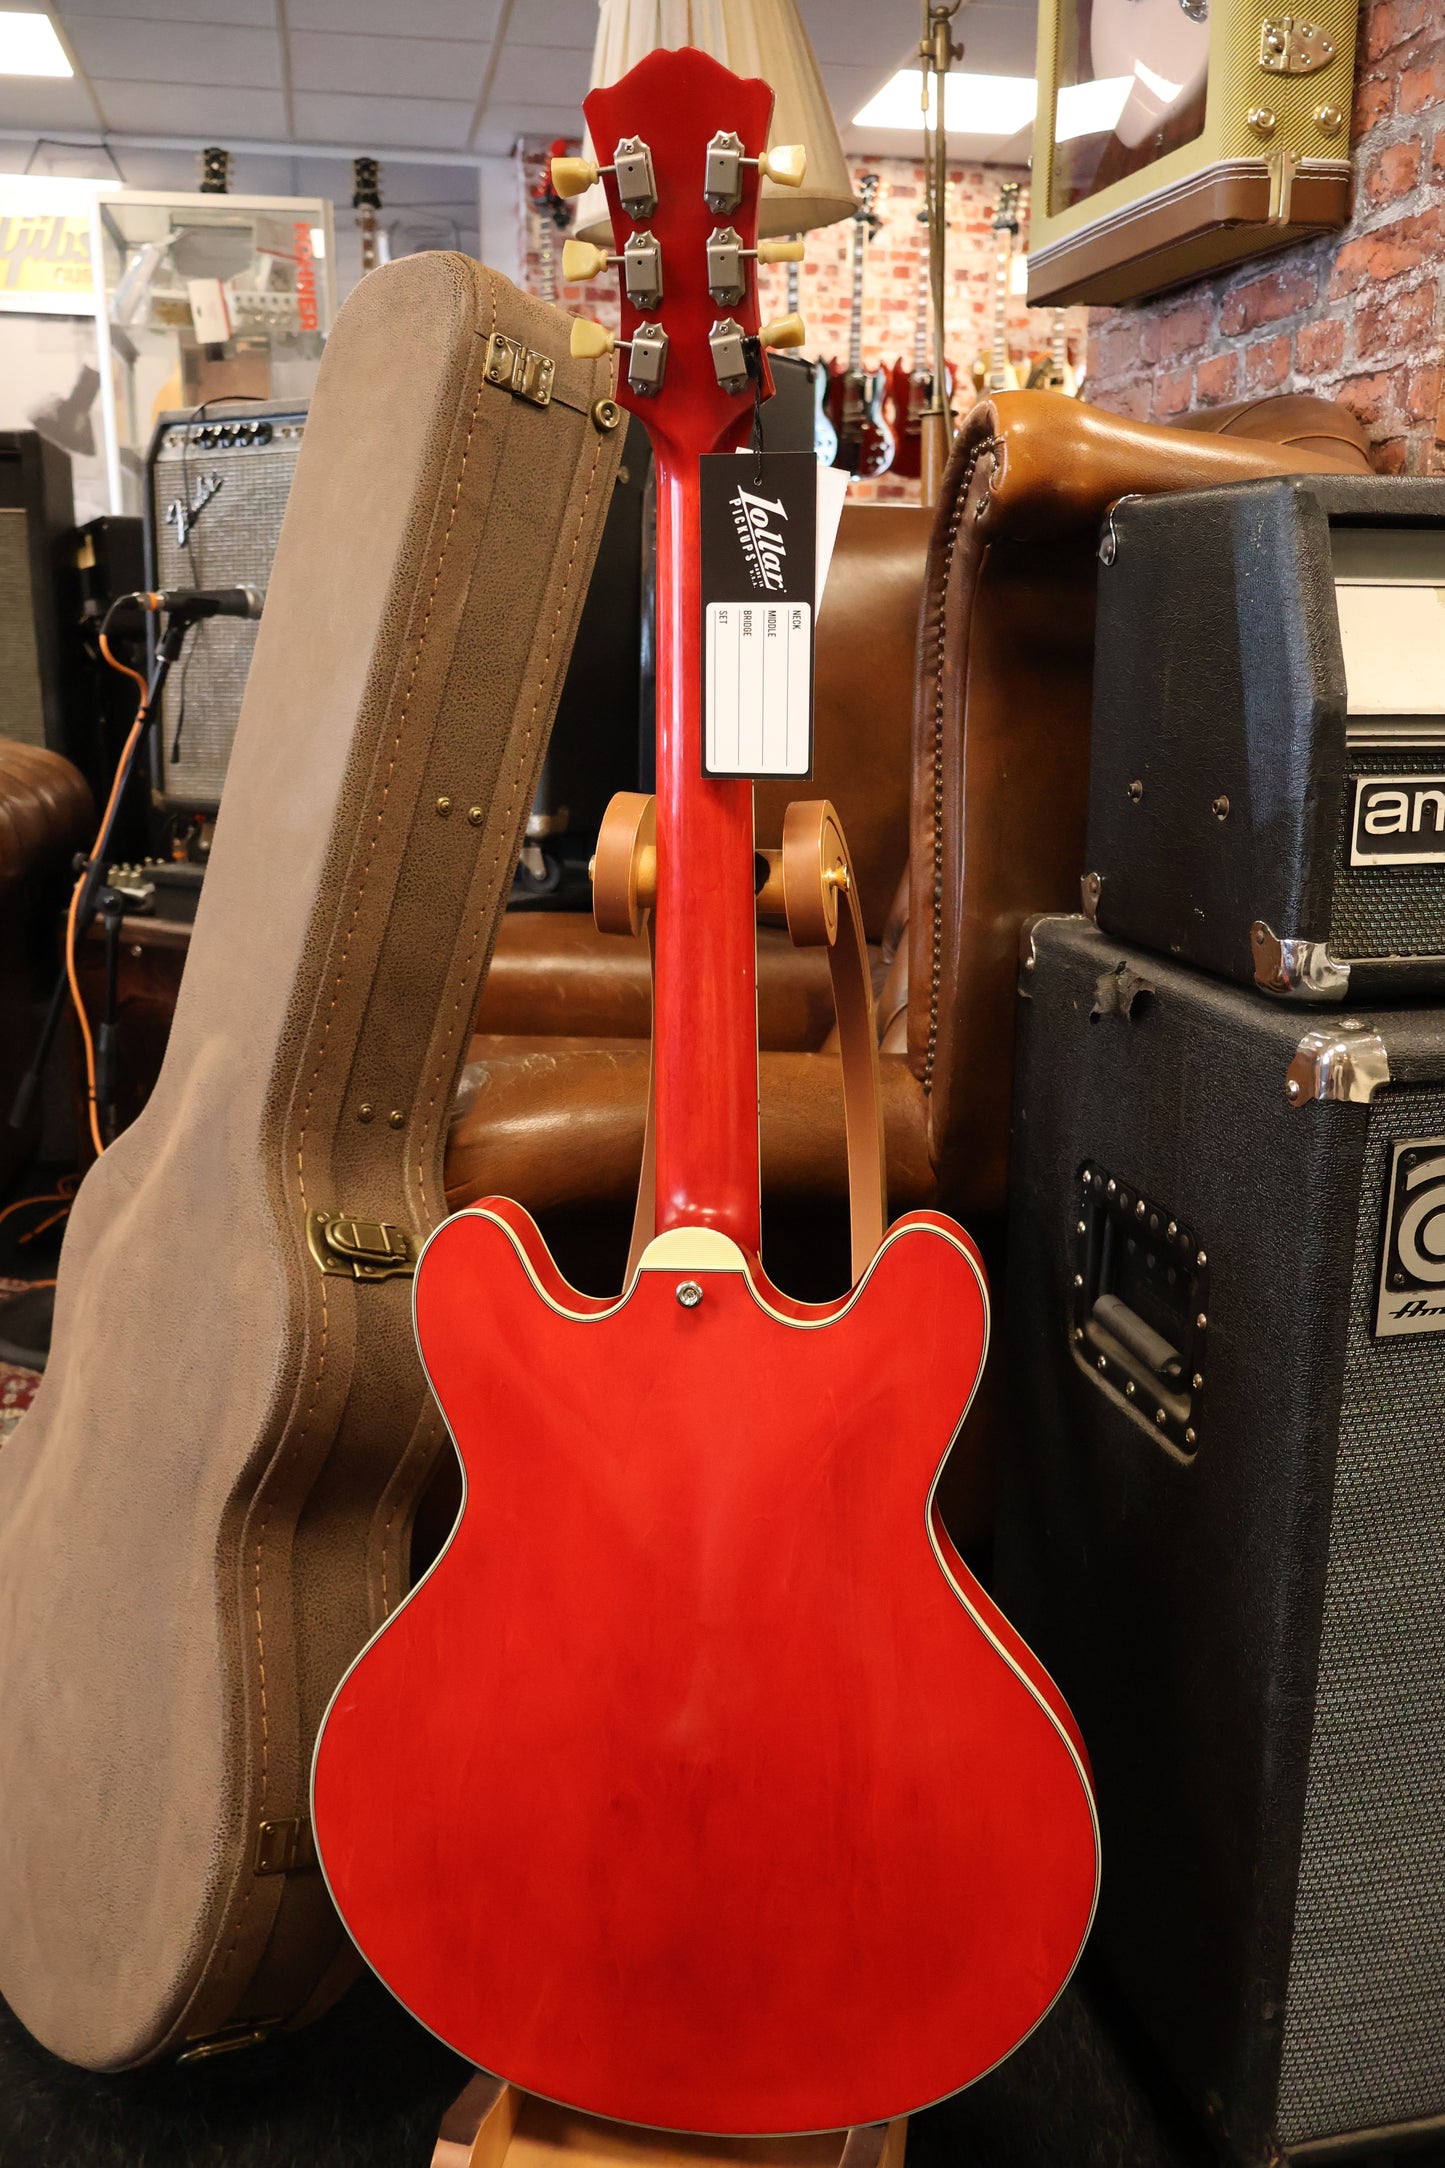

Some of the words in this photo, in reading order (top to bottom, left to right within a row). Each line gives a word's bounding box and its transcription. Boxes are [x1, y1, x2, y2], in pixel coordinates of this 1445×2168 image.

[293, 222, 319, 331] HOHNER
[728, 498, 756, 562] PICKUPS
[719, 610, 728, 625] SET
[743, 610, 752, 637] BRIDGE
[767, 610, 777, 637] MIDDLE
[792, 610, 802, 630] NECK
